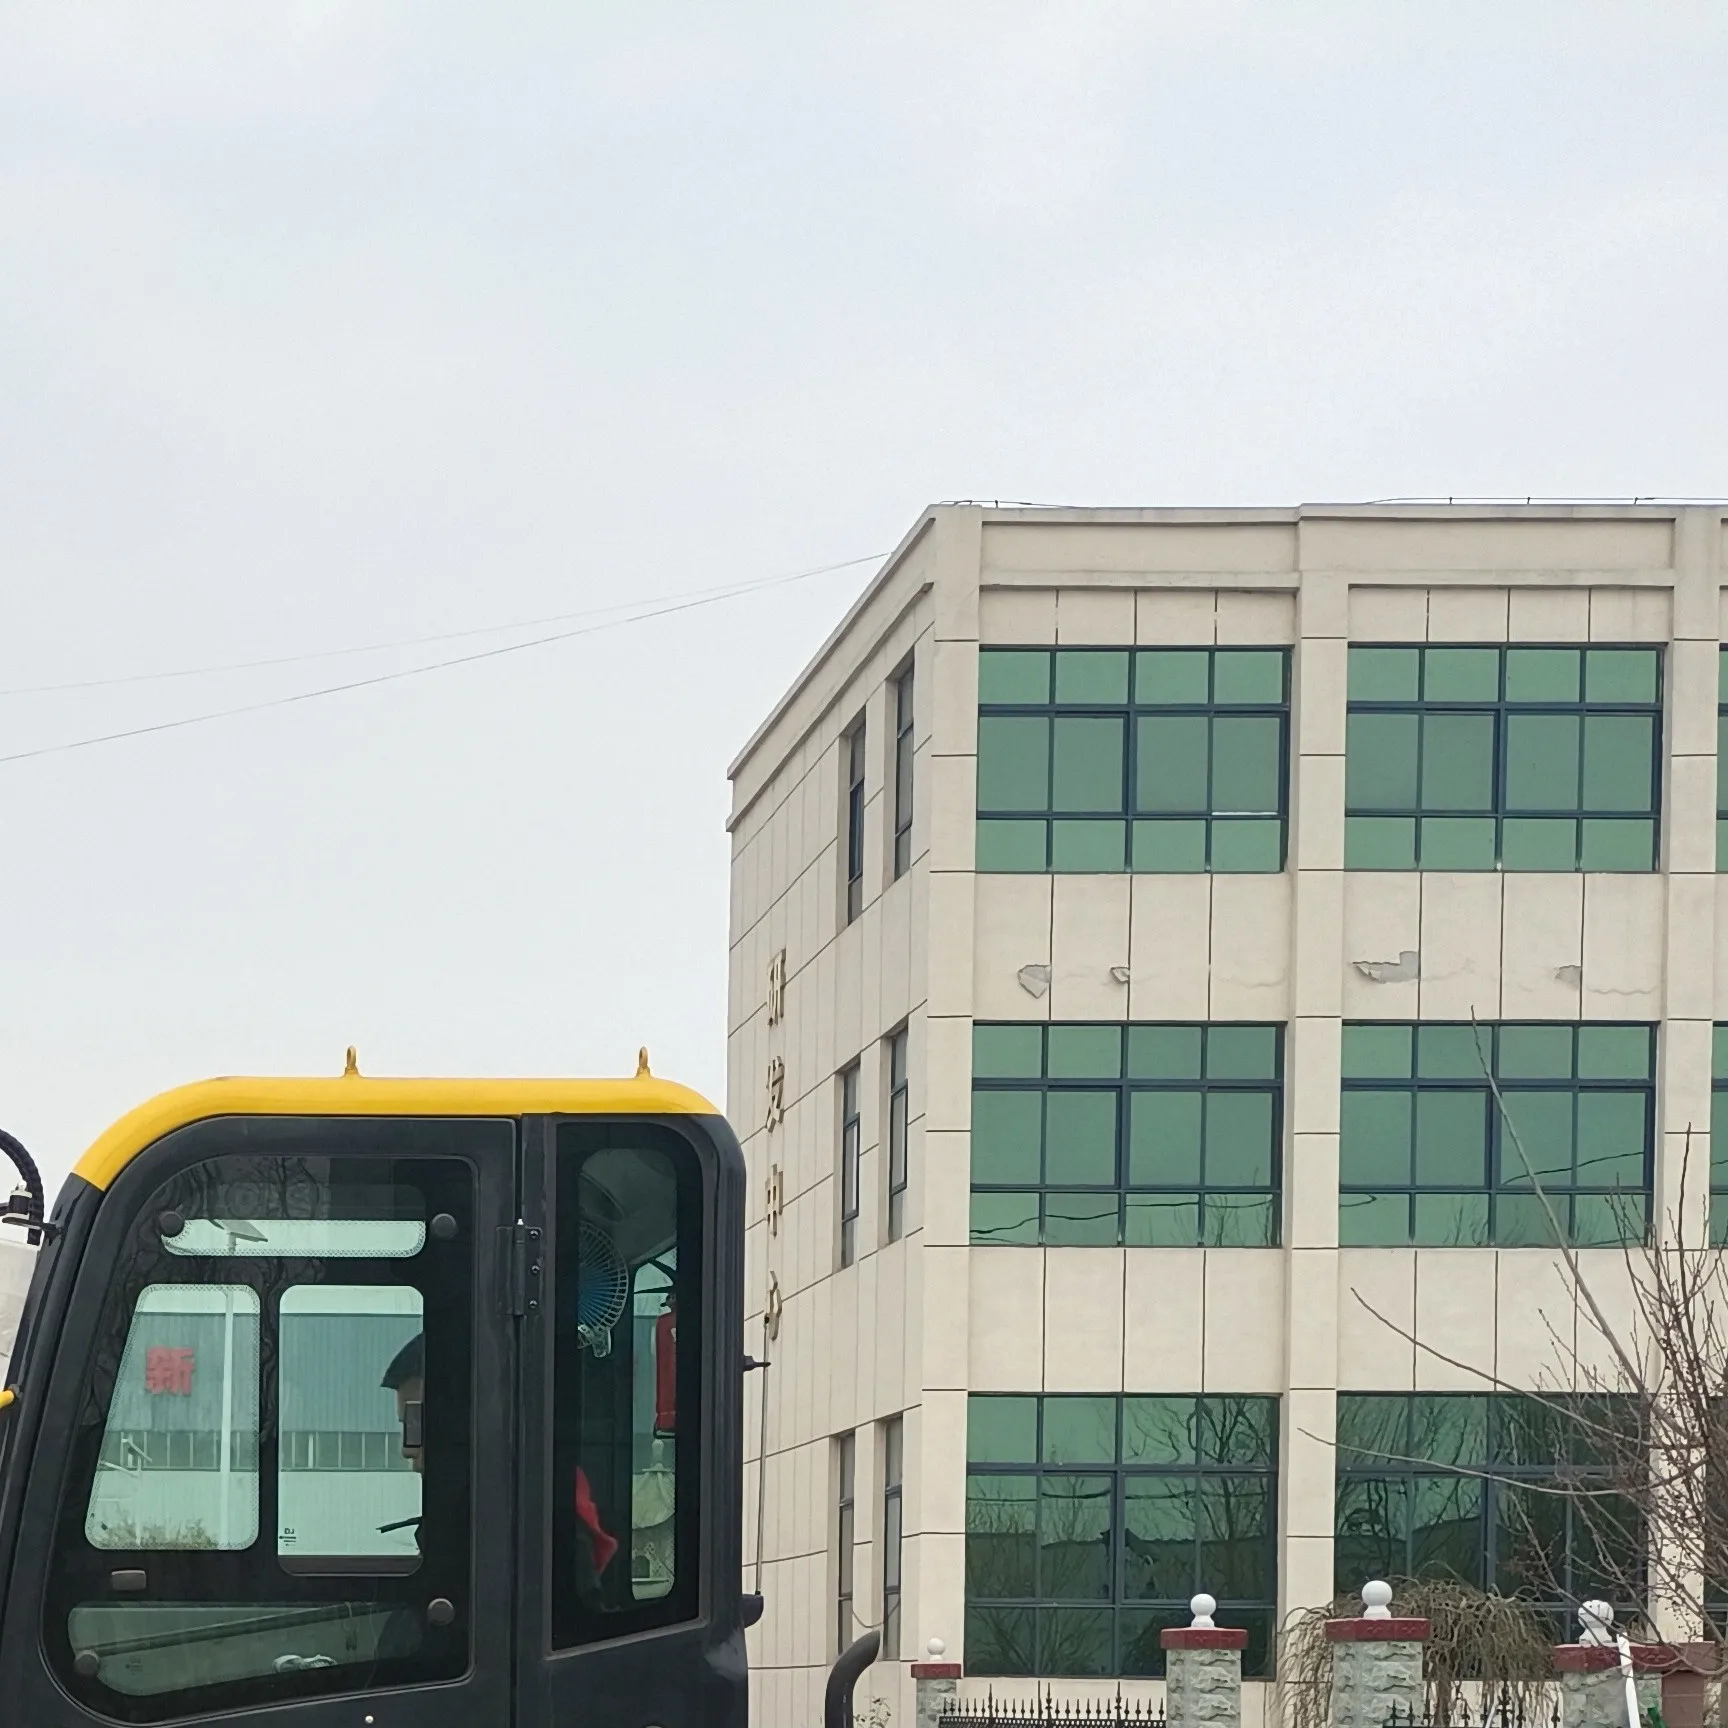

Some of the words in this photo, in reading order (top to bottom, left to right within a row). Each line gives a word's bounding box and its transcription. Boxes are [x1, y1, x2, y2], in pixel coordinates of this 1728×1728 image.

[764, 946, 787, 1341] 研发中心
[146, 1345, 196, 1396] 新
